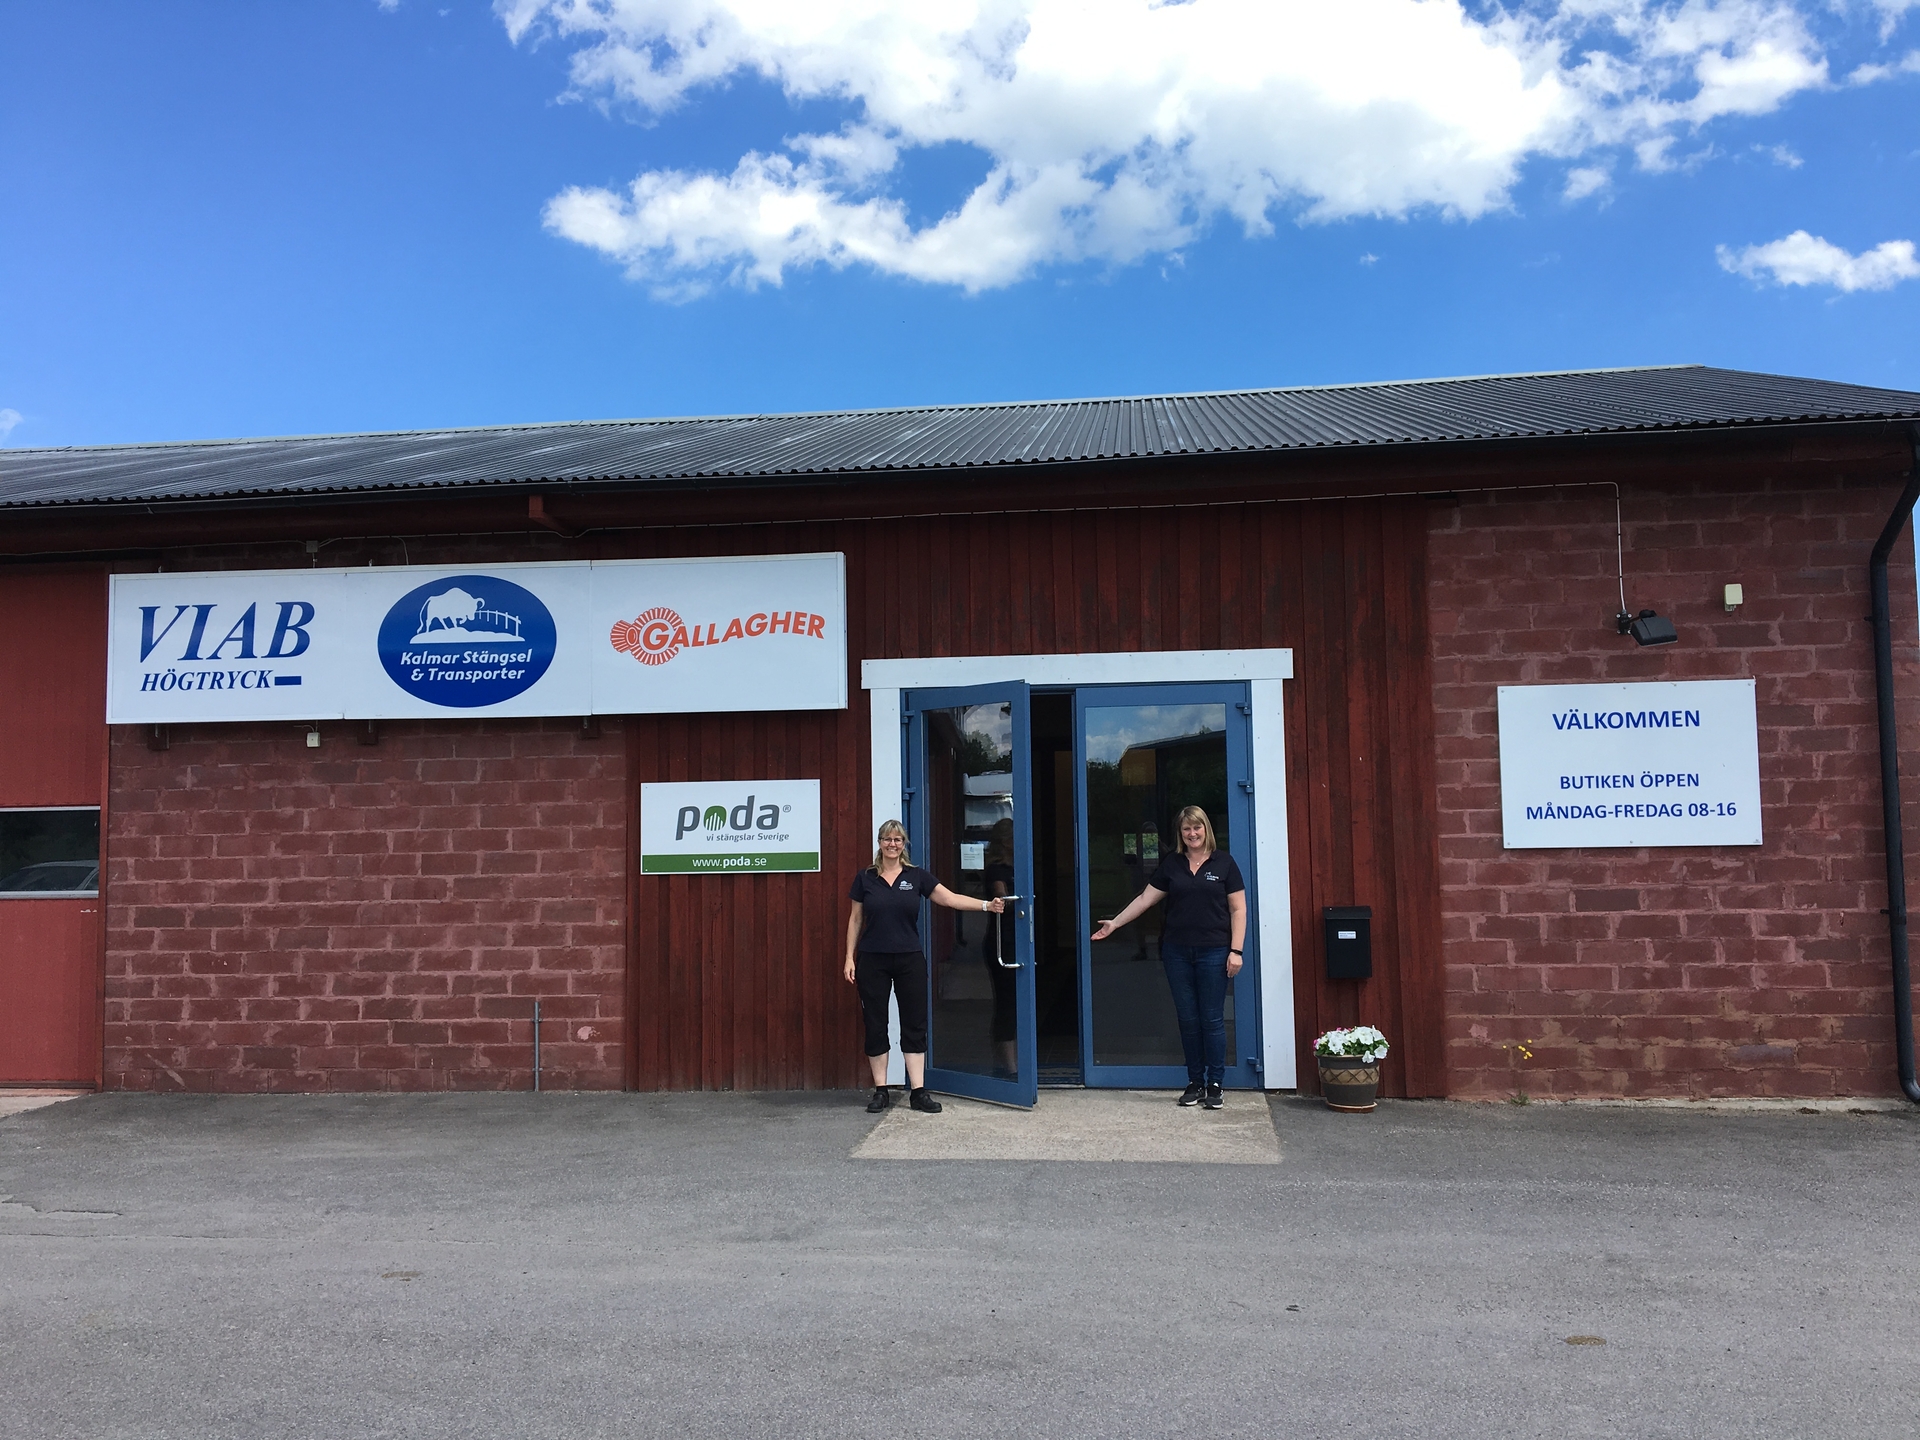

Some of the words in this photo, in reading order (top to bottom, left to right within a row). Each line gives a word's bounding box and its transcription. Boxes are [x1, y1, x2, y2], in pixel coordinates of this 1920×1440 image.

[138, 601, 315, 663] VIAB
[643, 611, 826, 650] GALLAGHER
[400, 650, 460, 666] Kalmar
[463, 648, 533, 667] Stängsel
[140, 668, 273, 692] HÖGTRYCK
[410, 667, 425, 682] &
[427, 665, 526, 683] Transporter
[1552, 708, 1700, 731] VÄLKOMMEN
[1560, 774, 1635, 790] BUTIKEN
[1640, 770, 1700, 788] ÖPPEN
[1526, 801, 1683, 820] MÅNDAG-FREDAG
[1688, 802, 1737, 818] 08-16
[706, 834, 714, 842] vi
[716, 832, 755, 843] stängslar
[757, 832, 790, 842] Sverige
[692, 855, 767, 868] www.poda.se
